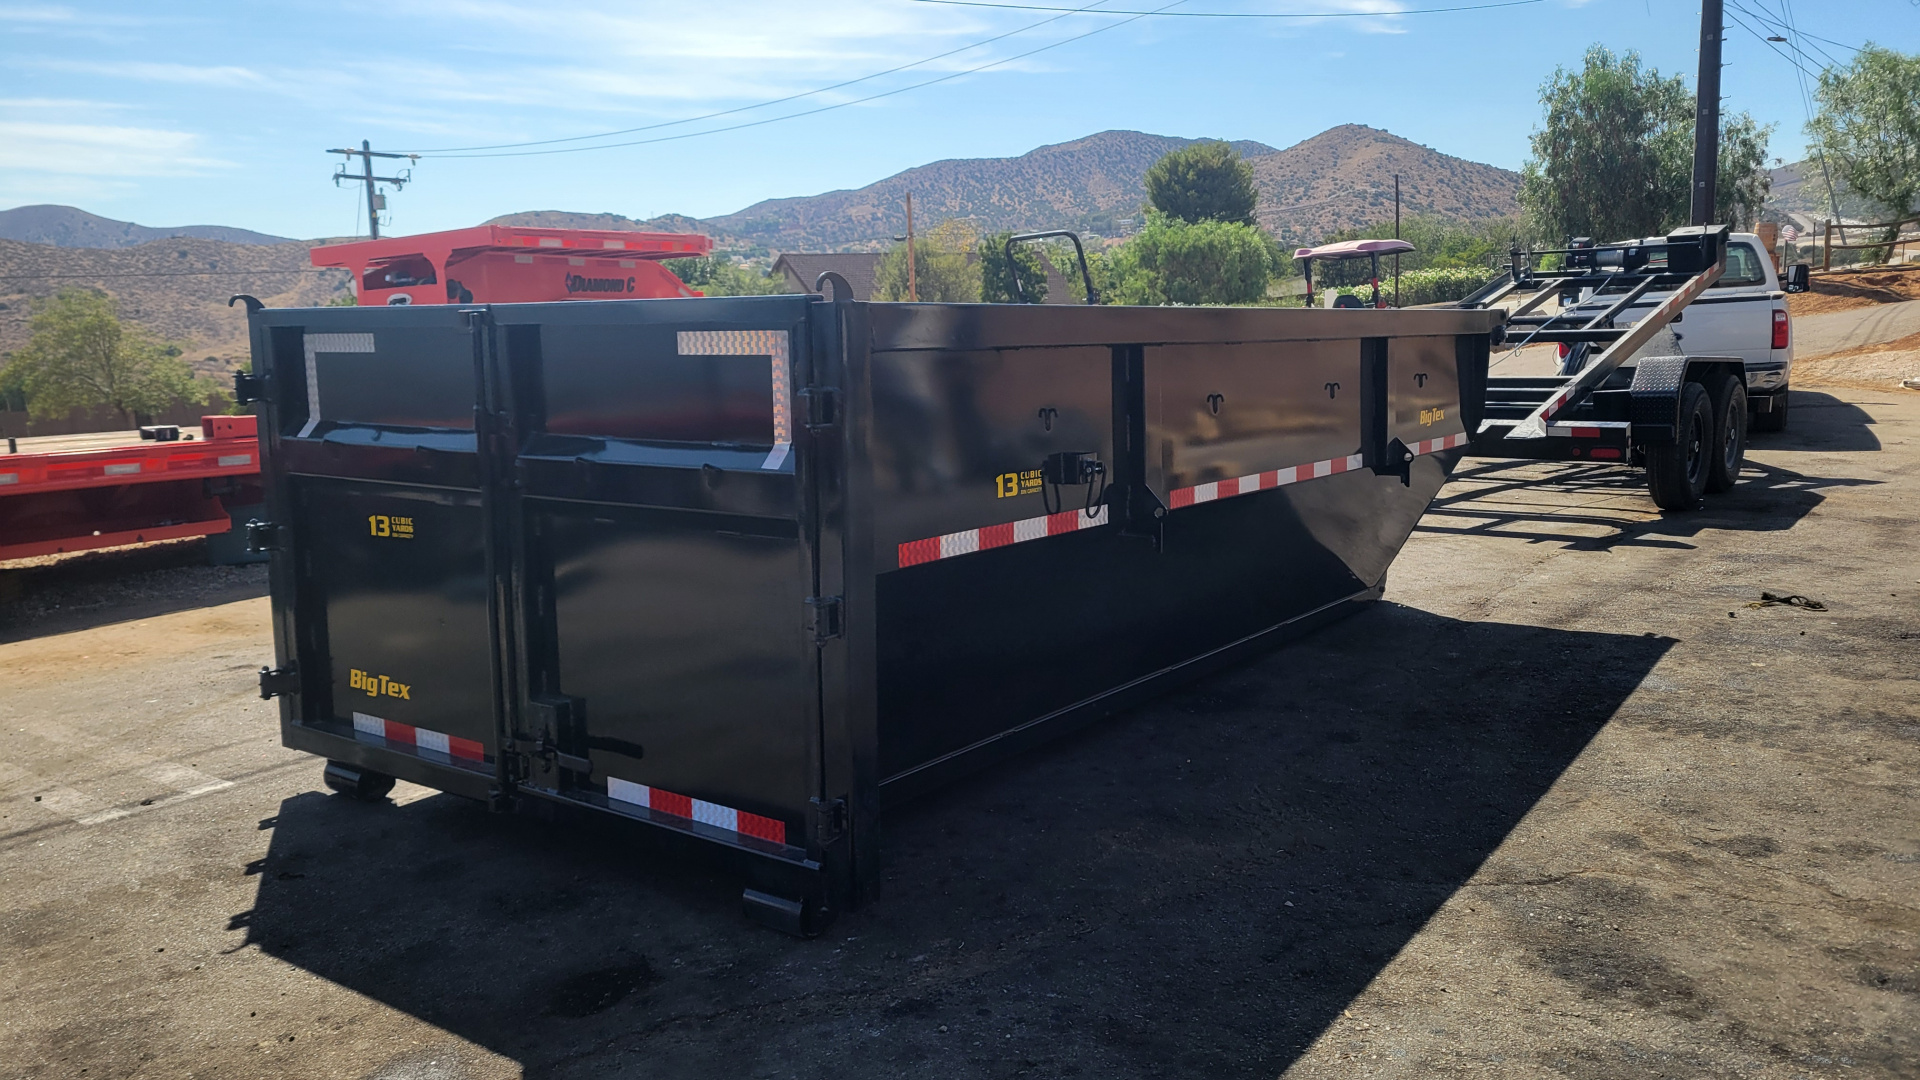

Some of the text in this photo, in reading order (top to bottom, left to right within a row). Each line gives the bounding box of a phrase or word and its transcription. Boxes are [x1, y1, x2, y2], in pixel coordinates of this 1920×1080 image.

[626, 276, 636, 293] C
[1020, 469, 1043, 480] CUBIC
[995, 472, 1019, 498] 13
[1020, 477, 1043, 488] YARDS
[368, 514, 390, 537] 13
[391, 516, 414, 525] CUBIC
[391, 524, 414, 533] YARDS
